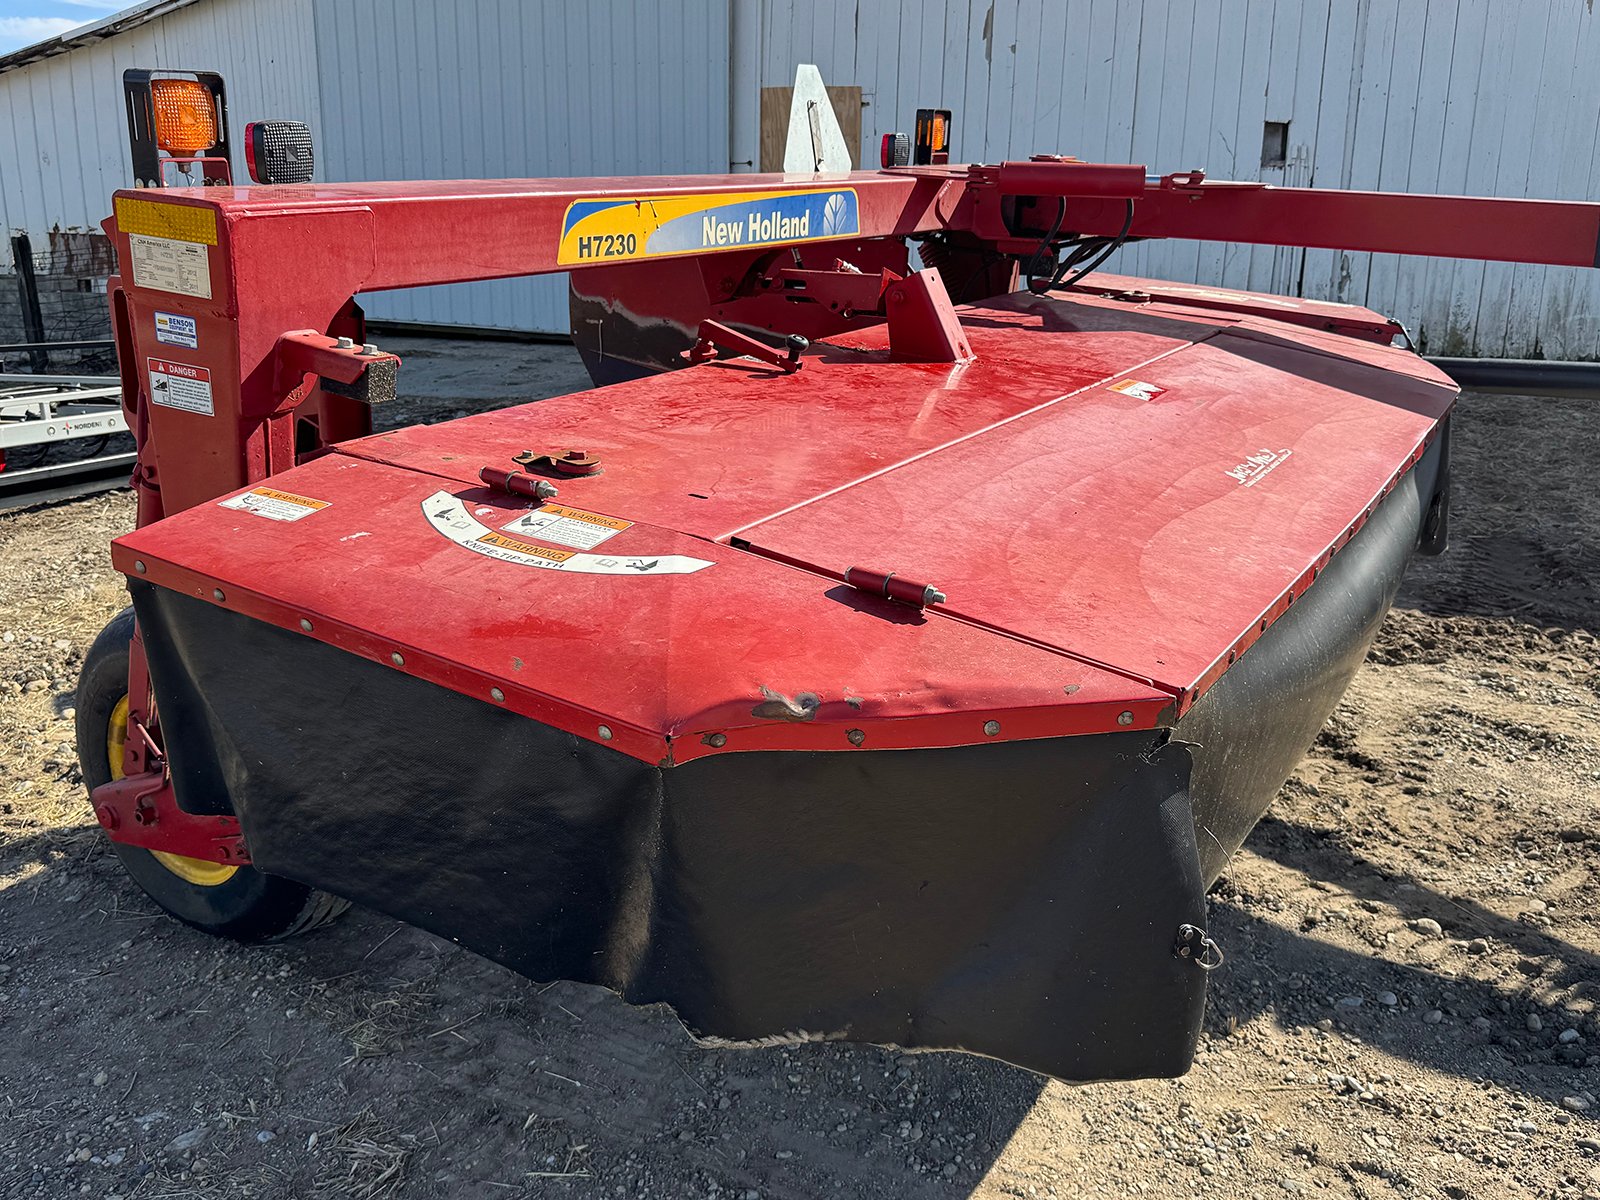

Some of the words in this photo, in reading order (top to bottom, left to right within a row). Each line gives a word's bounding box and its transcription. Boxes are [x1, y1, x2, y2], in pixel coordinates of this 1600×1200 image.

[702, 215, 743, 246] New
[748, 209, 810, 240] Holland
[578, 233, 637, 258] H7230
[168, 317, 194, 328] BENSON
[169, 365, 197, 378] DANGER
[74, 421, 100, 430] NORDEN
[568, 508, 618, 526] WARNING
[462, 540, 564, 568] KNIFE-TIP-PATH
[500, 539, 565, 560] WARNING
